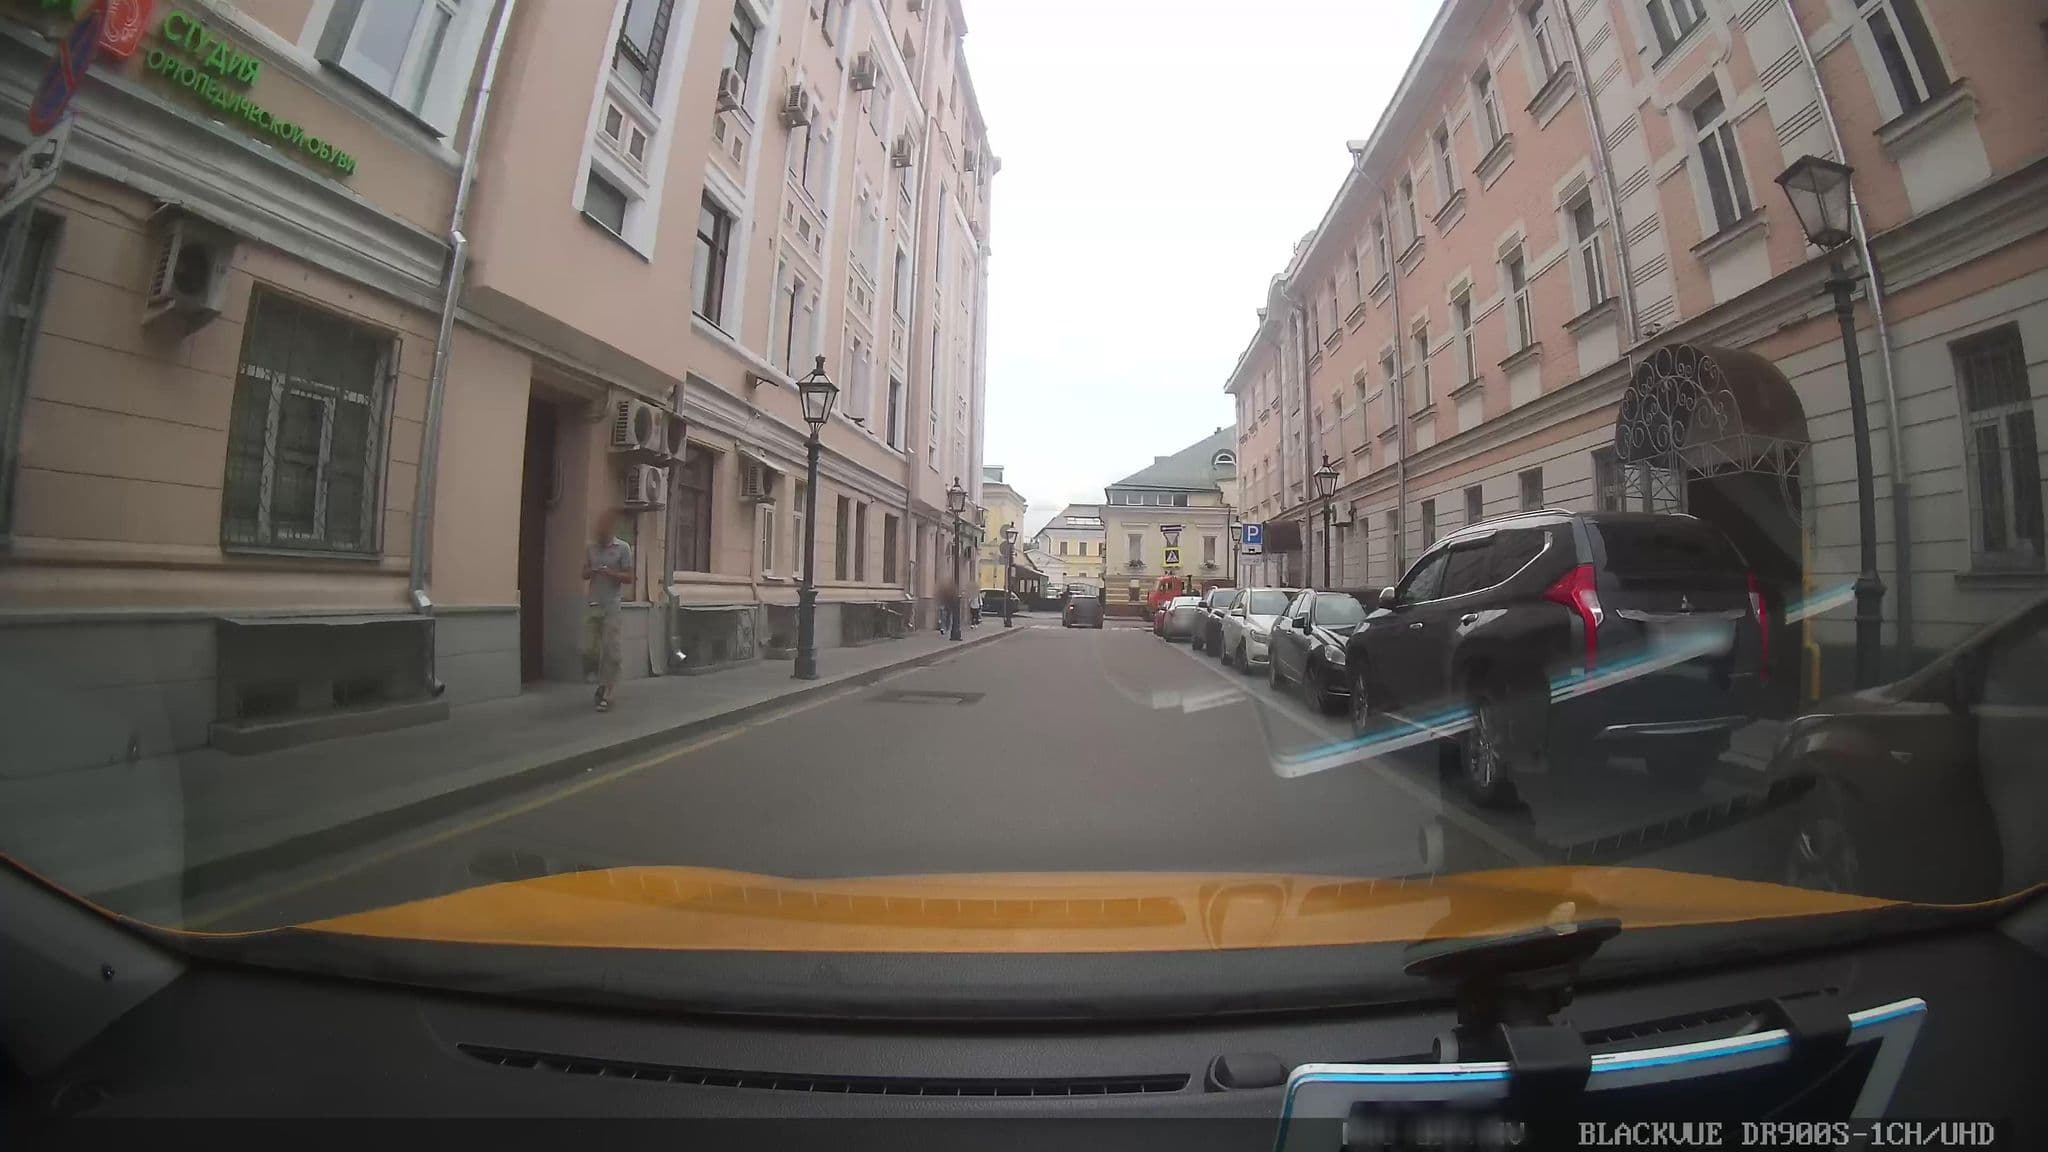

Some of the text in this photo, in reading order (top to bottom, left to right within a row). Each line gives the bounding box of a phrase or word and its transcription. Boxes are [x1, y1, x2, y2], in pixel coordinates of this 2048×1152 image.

[163, 10, 262, 87] СТУДИЯ
[147, 49, 358, 175] ОРТОПЕДИЧЕСКОЙ ОБУВИ
[1247, 525, 1259, 542] P
